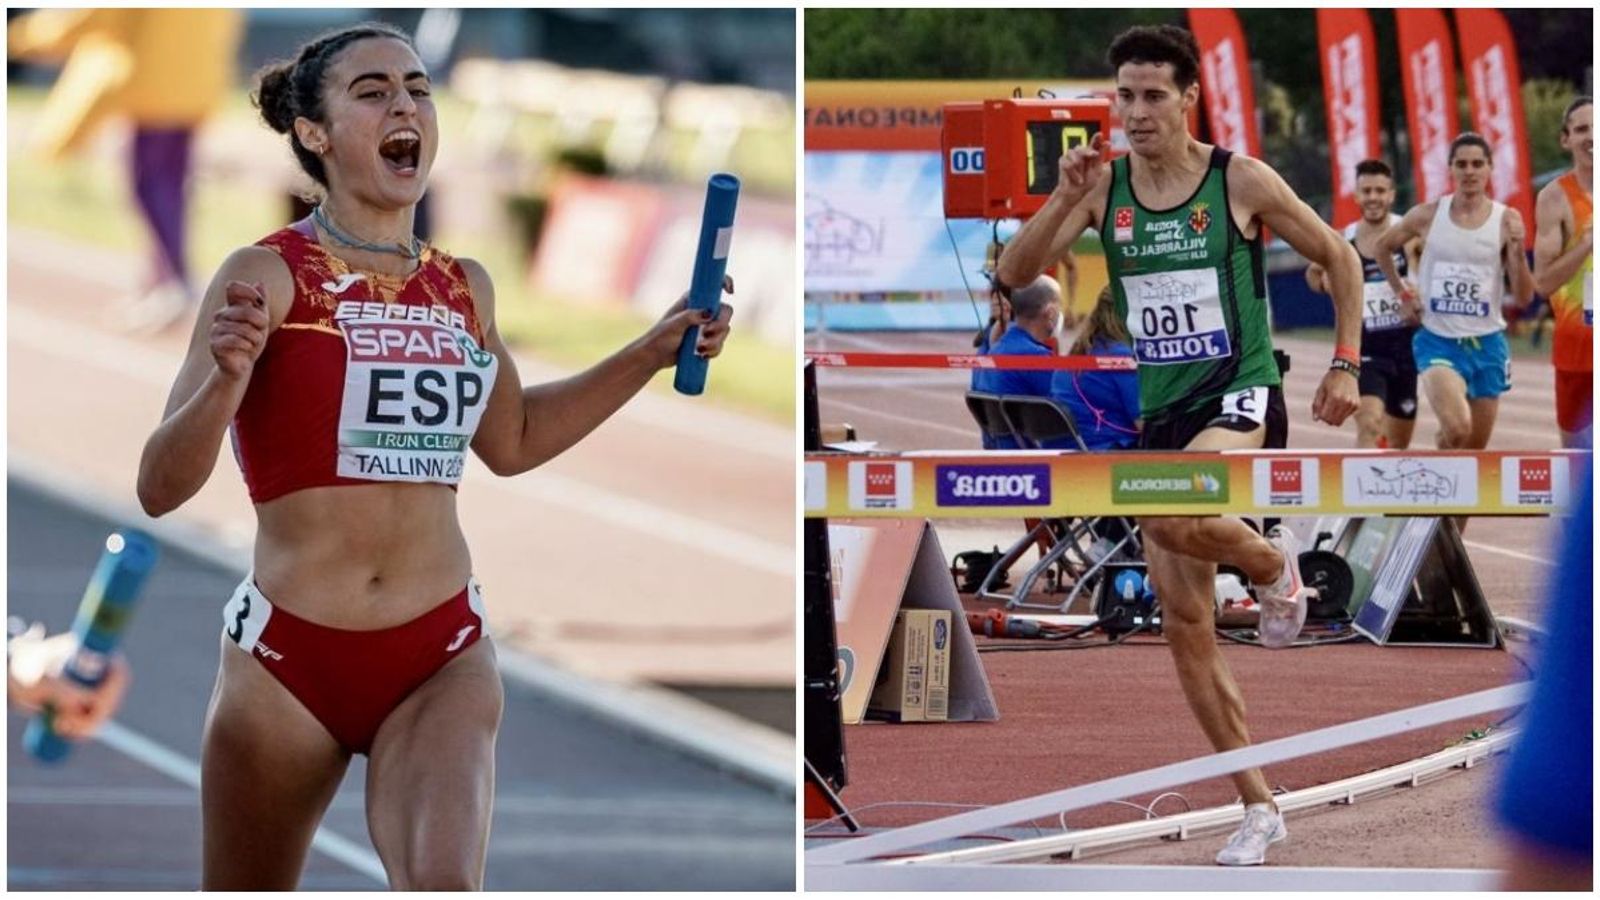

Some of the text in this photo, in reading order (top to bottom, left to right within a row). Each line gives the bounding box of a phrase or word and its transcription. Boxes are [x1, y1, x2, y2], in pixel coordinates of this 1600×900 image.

[351, 327, 462, 359] SPAR
[365, 368, 483, 427] ESP
[377, 432, 382, 446] I
[385, 433, 420, 449] RUN
[356, 454, 443, 477] TALLINN
